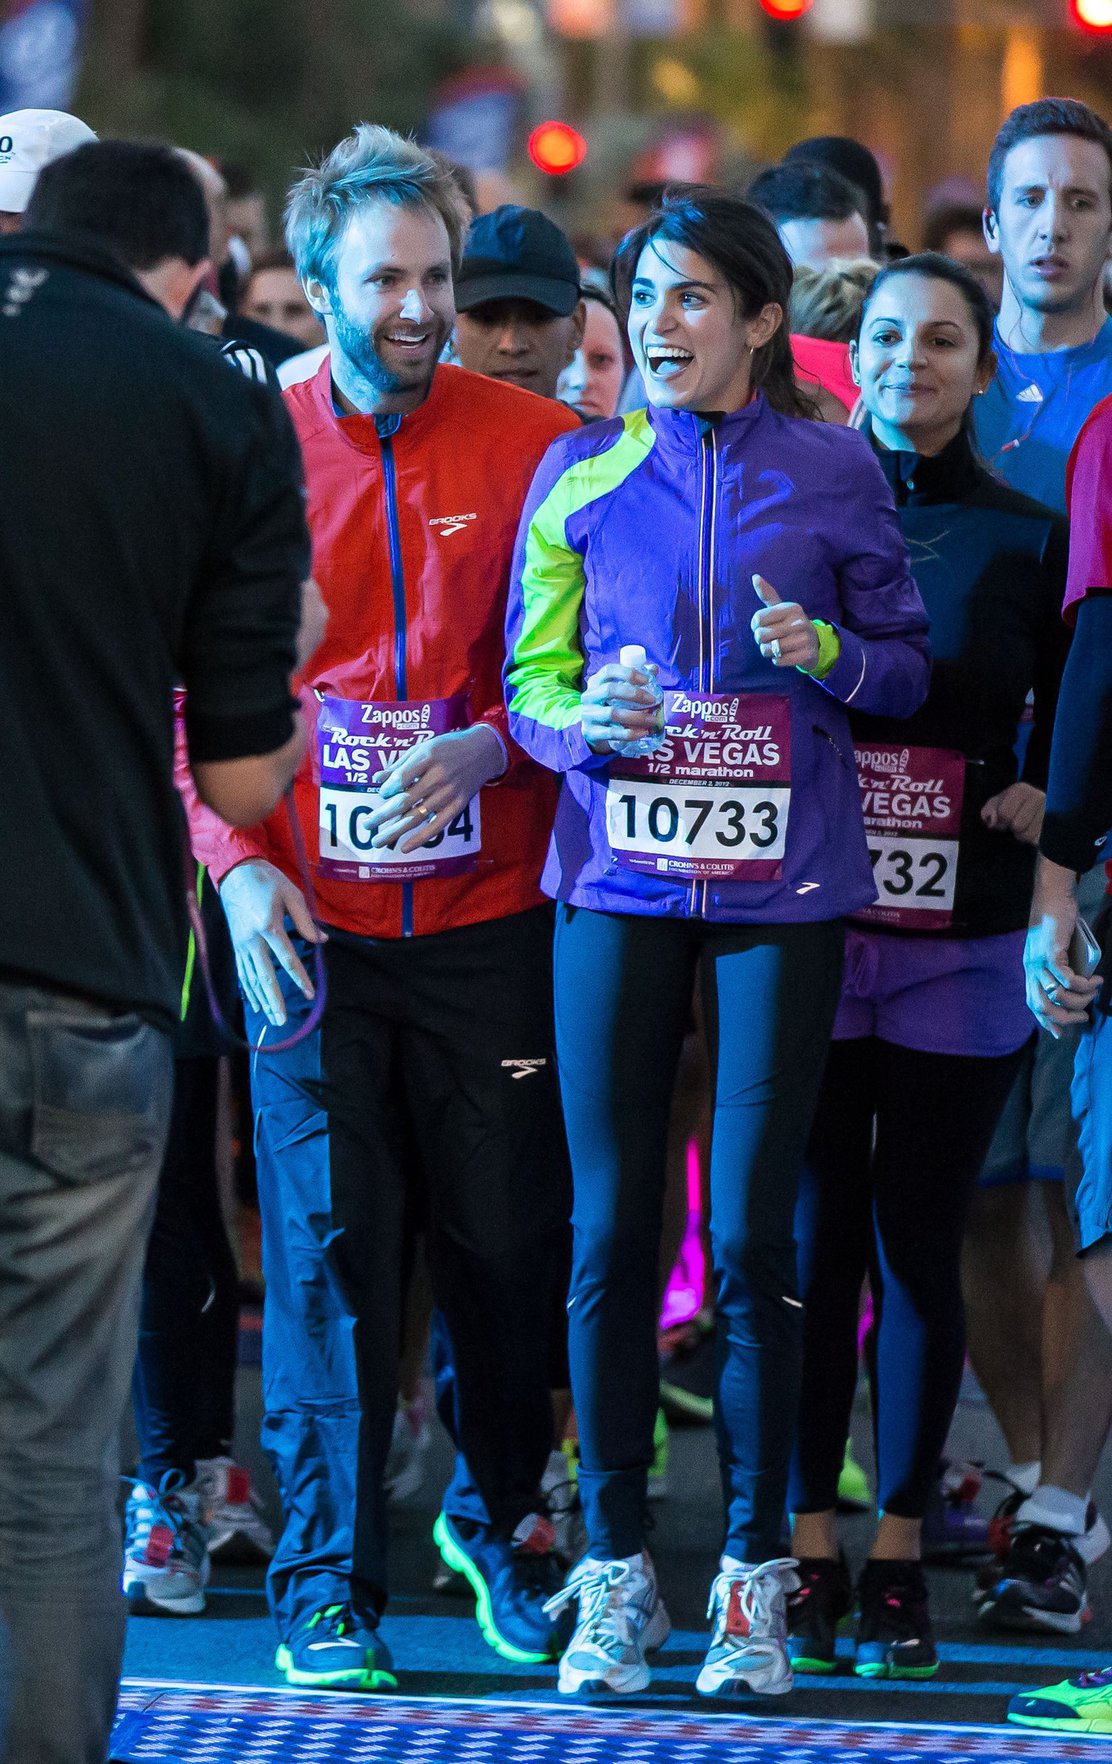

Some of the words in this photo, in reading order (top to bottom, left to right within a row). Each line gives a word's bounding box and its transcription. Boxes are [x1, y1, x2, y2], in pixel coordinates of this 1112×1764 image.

[429, 513, 477, 525] BROOKS
[323, 726, 392, 748] Rock
[664, 724, 698, 739] ck
[721, 724, 772, 741] Roll
[323, 744, 370, 771] LAS
[684, 741, 780, 766] VEGAS
[345, 771, 368, 783] 1/2
[648, 763, 670, 774] 1/2
[675, 766, 753, 777] marathon
[890, 774, 944, 794] Roll
[325, 803, 473, 850] 104
[619, 795, 778, 847] 10733
[864, 816, 922, 829] arathon
